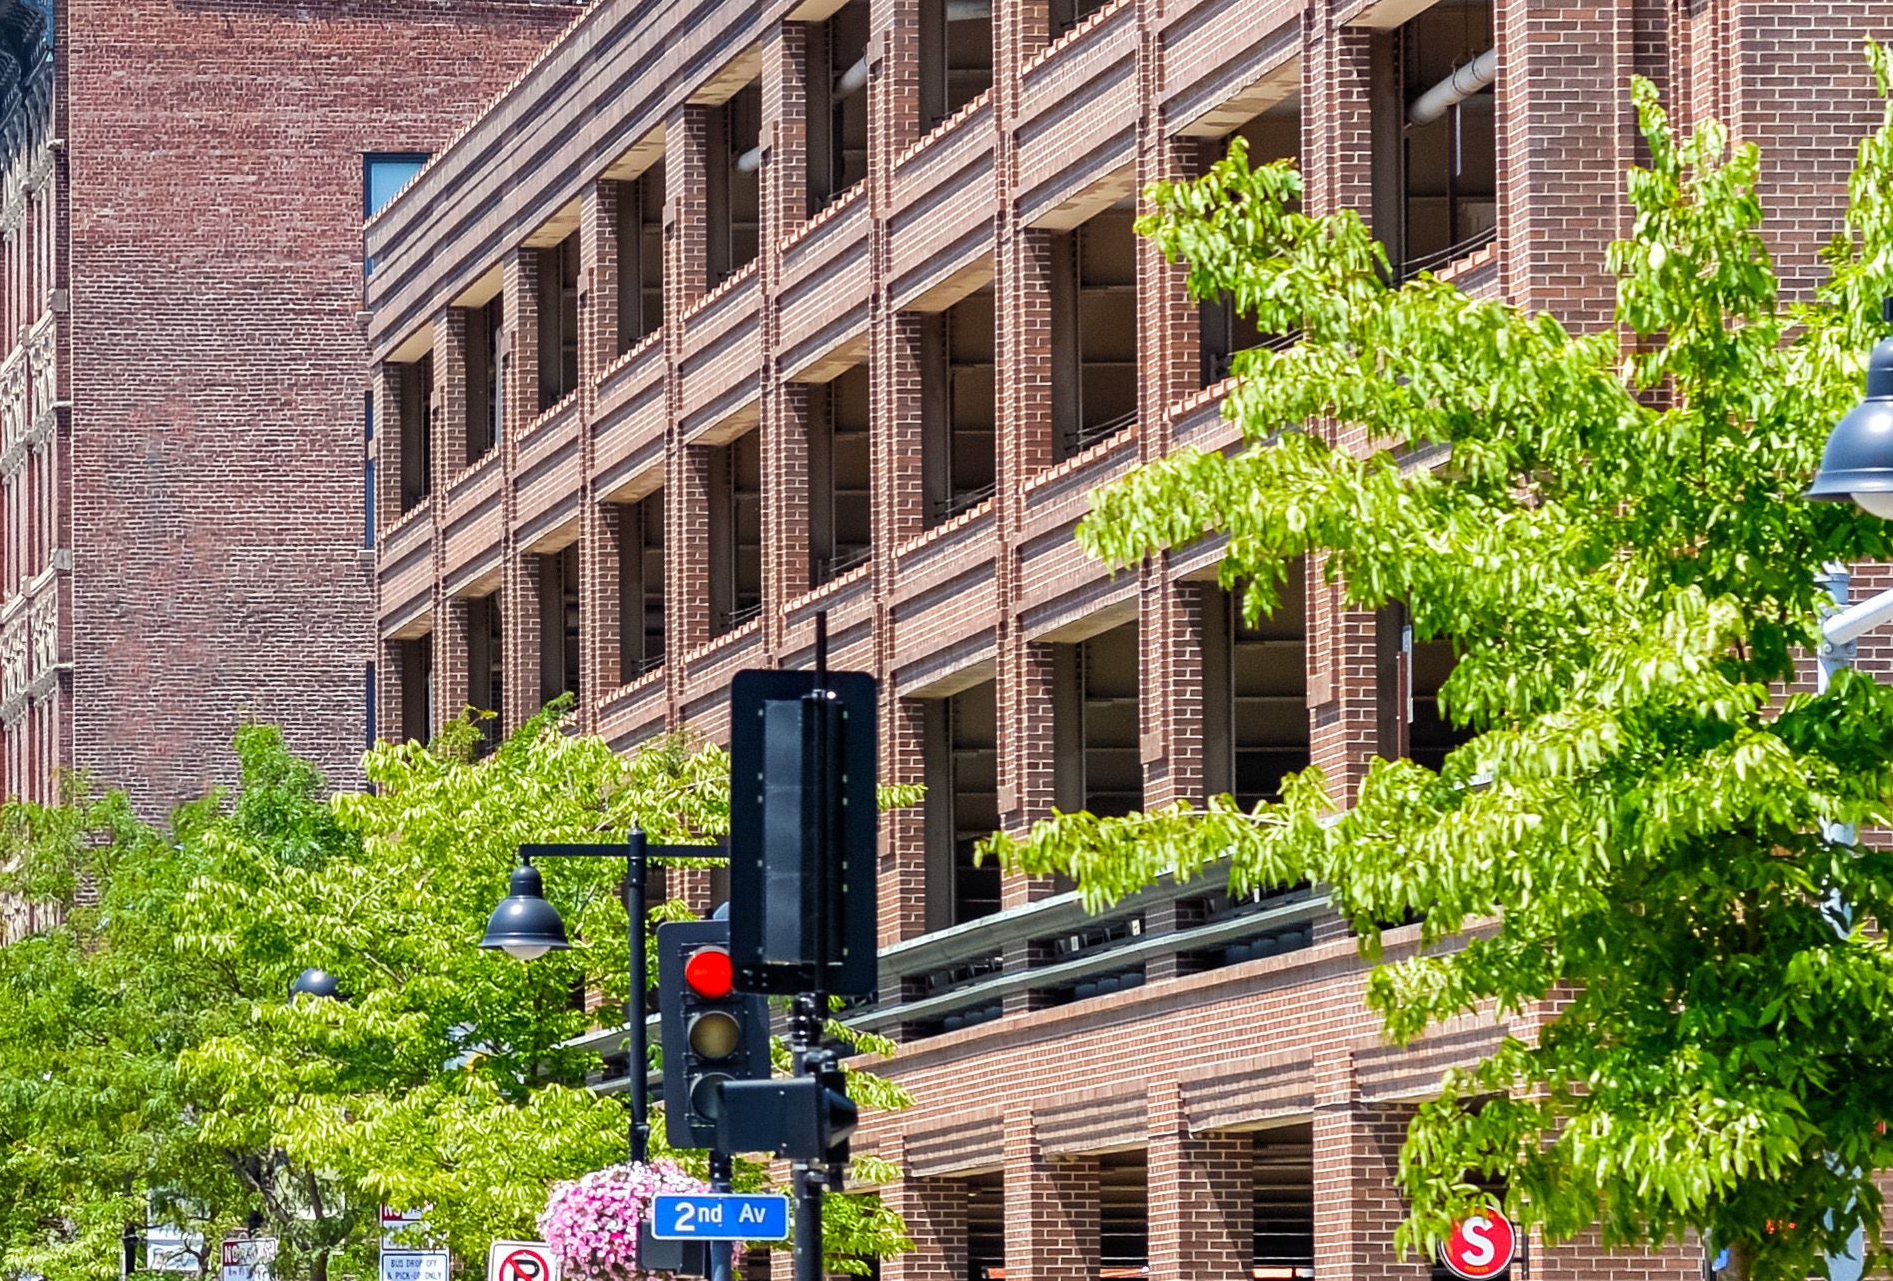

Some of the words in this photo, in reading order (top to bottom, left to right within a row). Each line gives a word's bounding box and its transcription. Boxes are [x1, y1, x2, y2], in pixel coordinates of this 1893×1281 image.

[674, 1201, 723, 1232] 2nd
[738, 1202, 766, 1223] Av
[1461, 1215, 1495, 1266] S
[390, 1259, 404, 1268] BUS
[406, 1259, 423, 1268] DROP
[424, 1272, 442, 1280] ONLY
